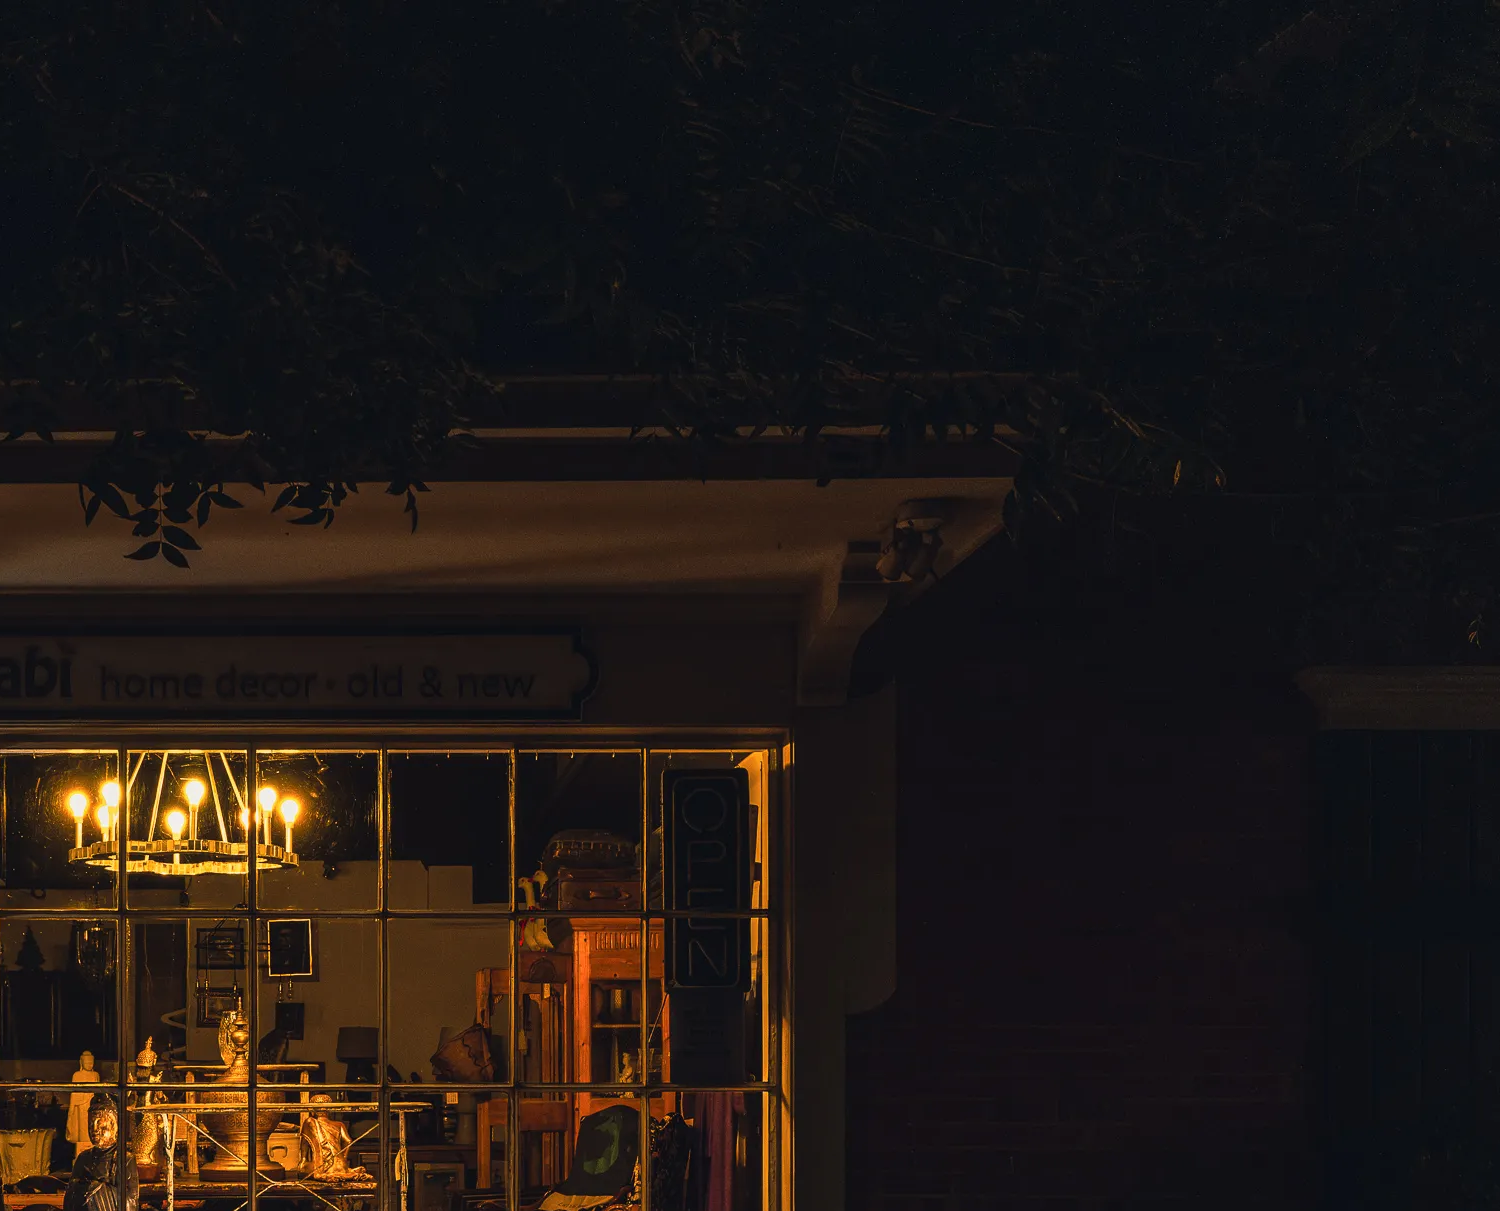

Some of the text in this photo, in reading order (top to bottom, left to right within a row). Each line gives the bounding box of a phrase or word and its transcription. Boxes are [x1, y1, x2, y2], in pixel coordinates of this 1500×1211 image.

[101, 664, 200, 700] home
[215, 664, 315, 700] decor
[347, 664, 404, 699] old
[419, 668, 443, 698] &
[459, 672, 535, 699] new
[681, 787, 729, 979] OPEN
